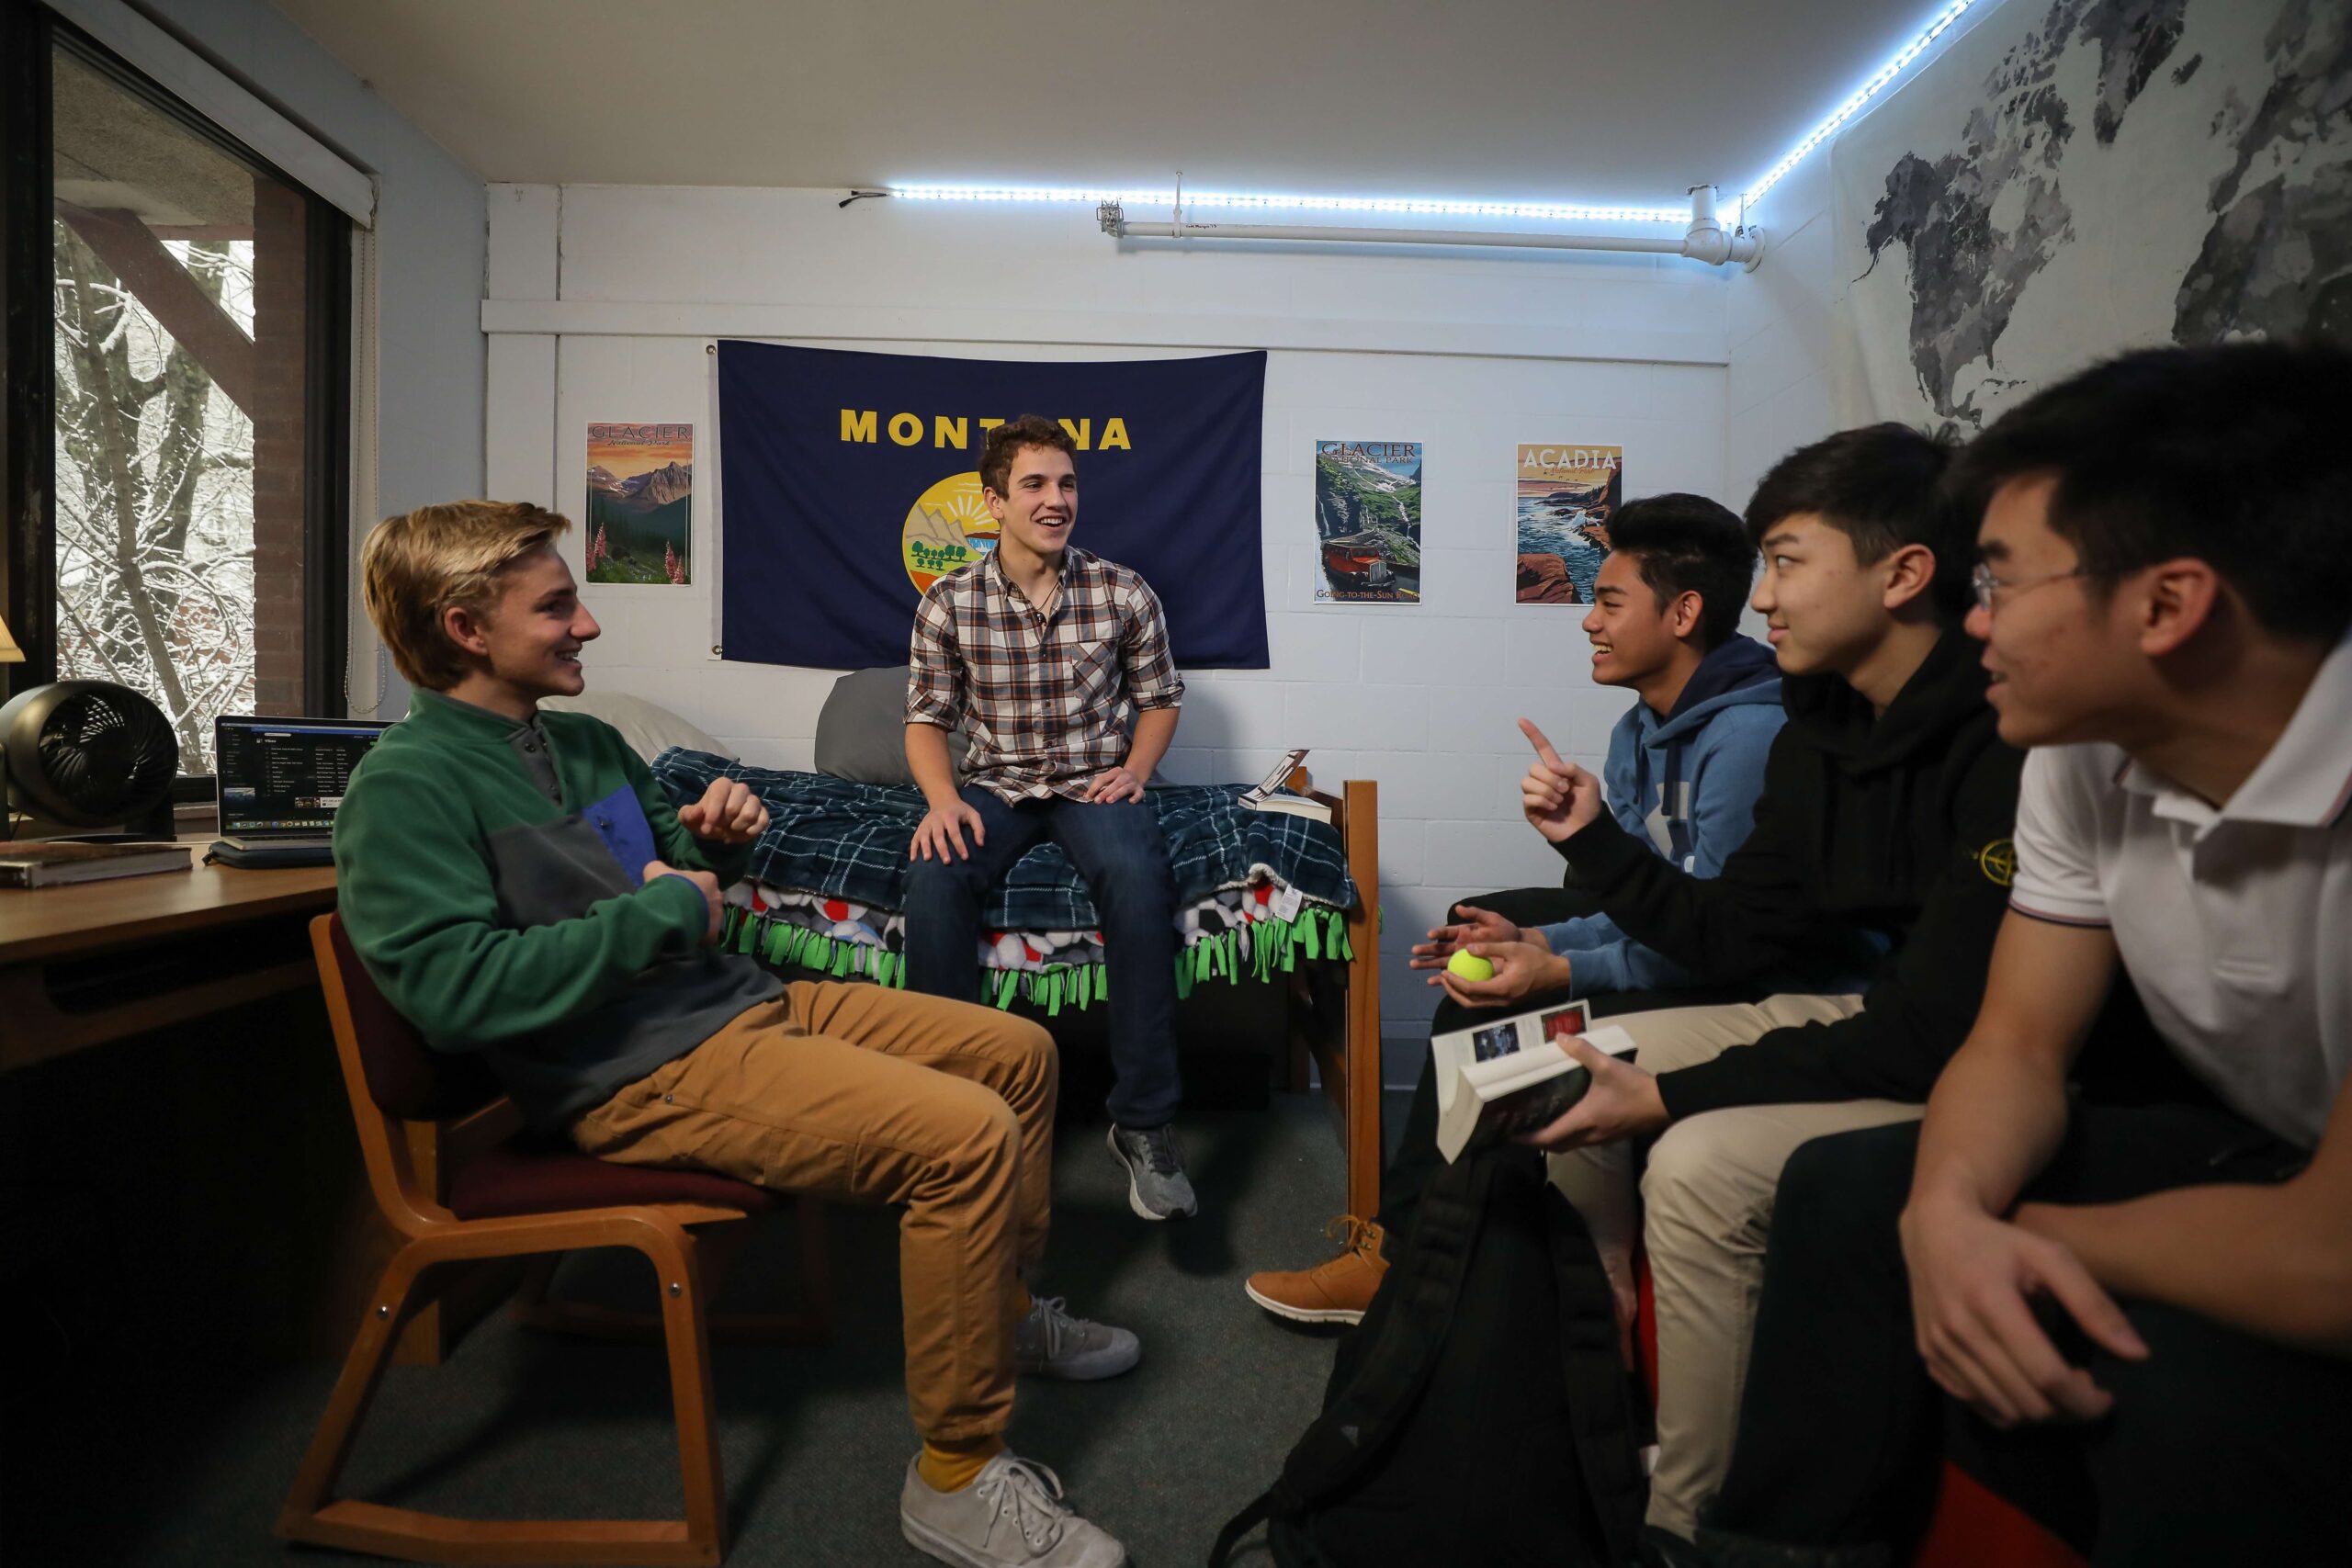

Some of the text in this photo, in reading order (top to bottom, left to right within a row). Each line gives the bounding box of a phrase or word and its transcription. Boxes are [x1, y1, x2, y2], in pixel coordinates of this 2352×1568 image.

[592, 426, 688, 439] GLACIER
[841, 409, 1131, 450] MONTNA
[1322, 443, 1416, 457] GLACIER
[1524, 448, 1617, 469] ACADIA
